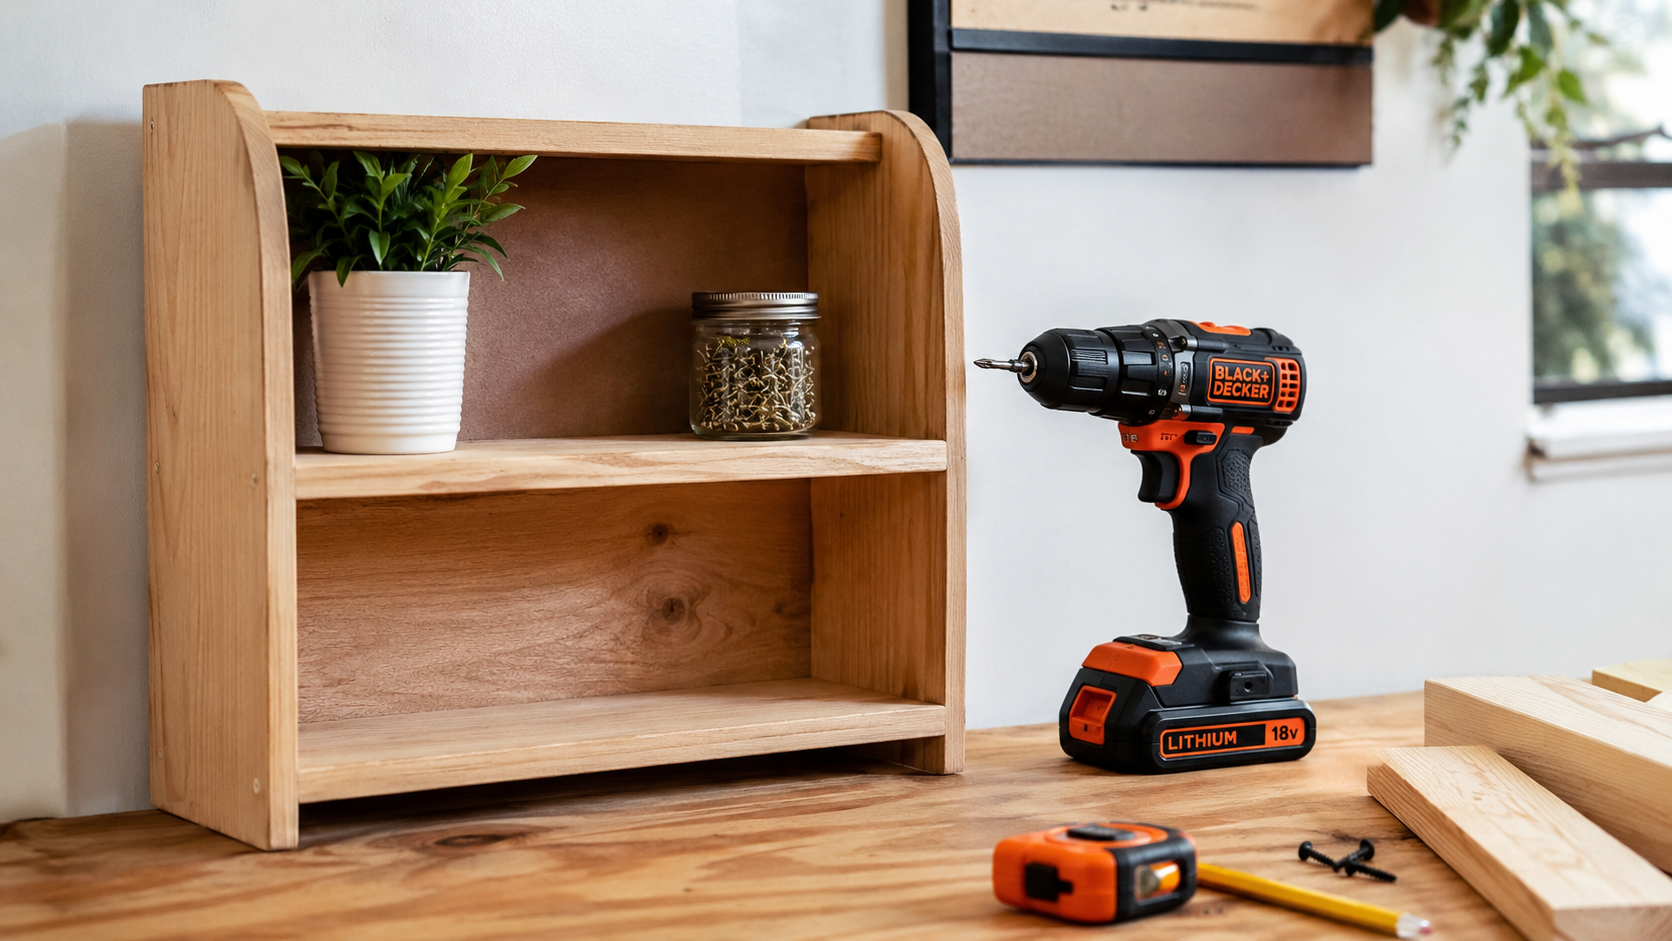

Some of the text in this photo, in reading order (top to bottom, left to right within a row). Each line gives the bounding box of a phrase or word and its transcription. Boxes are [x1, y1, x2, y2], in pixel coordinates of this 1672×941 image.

[1214, 365, 1269, 383] BLACK+
[1213, 381, 1269, 399] DECKER
[1168, 730, 1237, 751] LITHIUM
